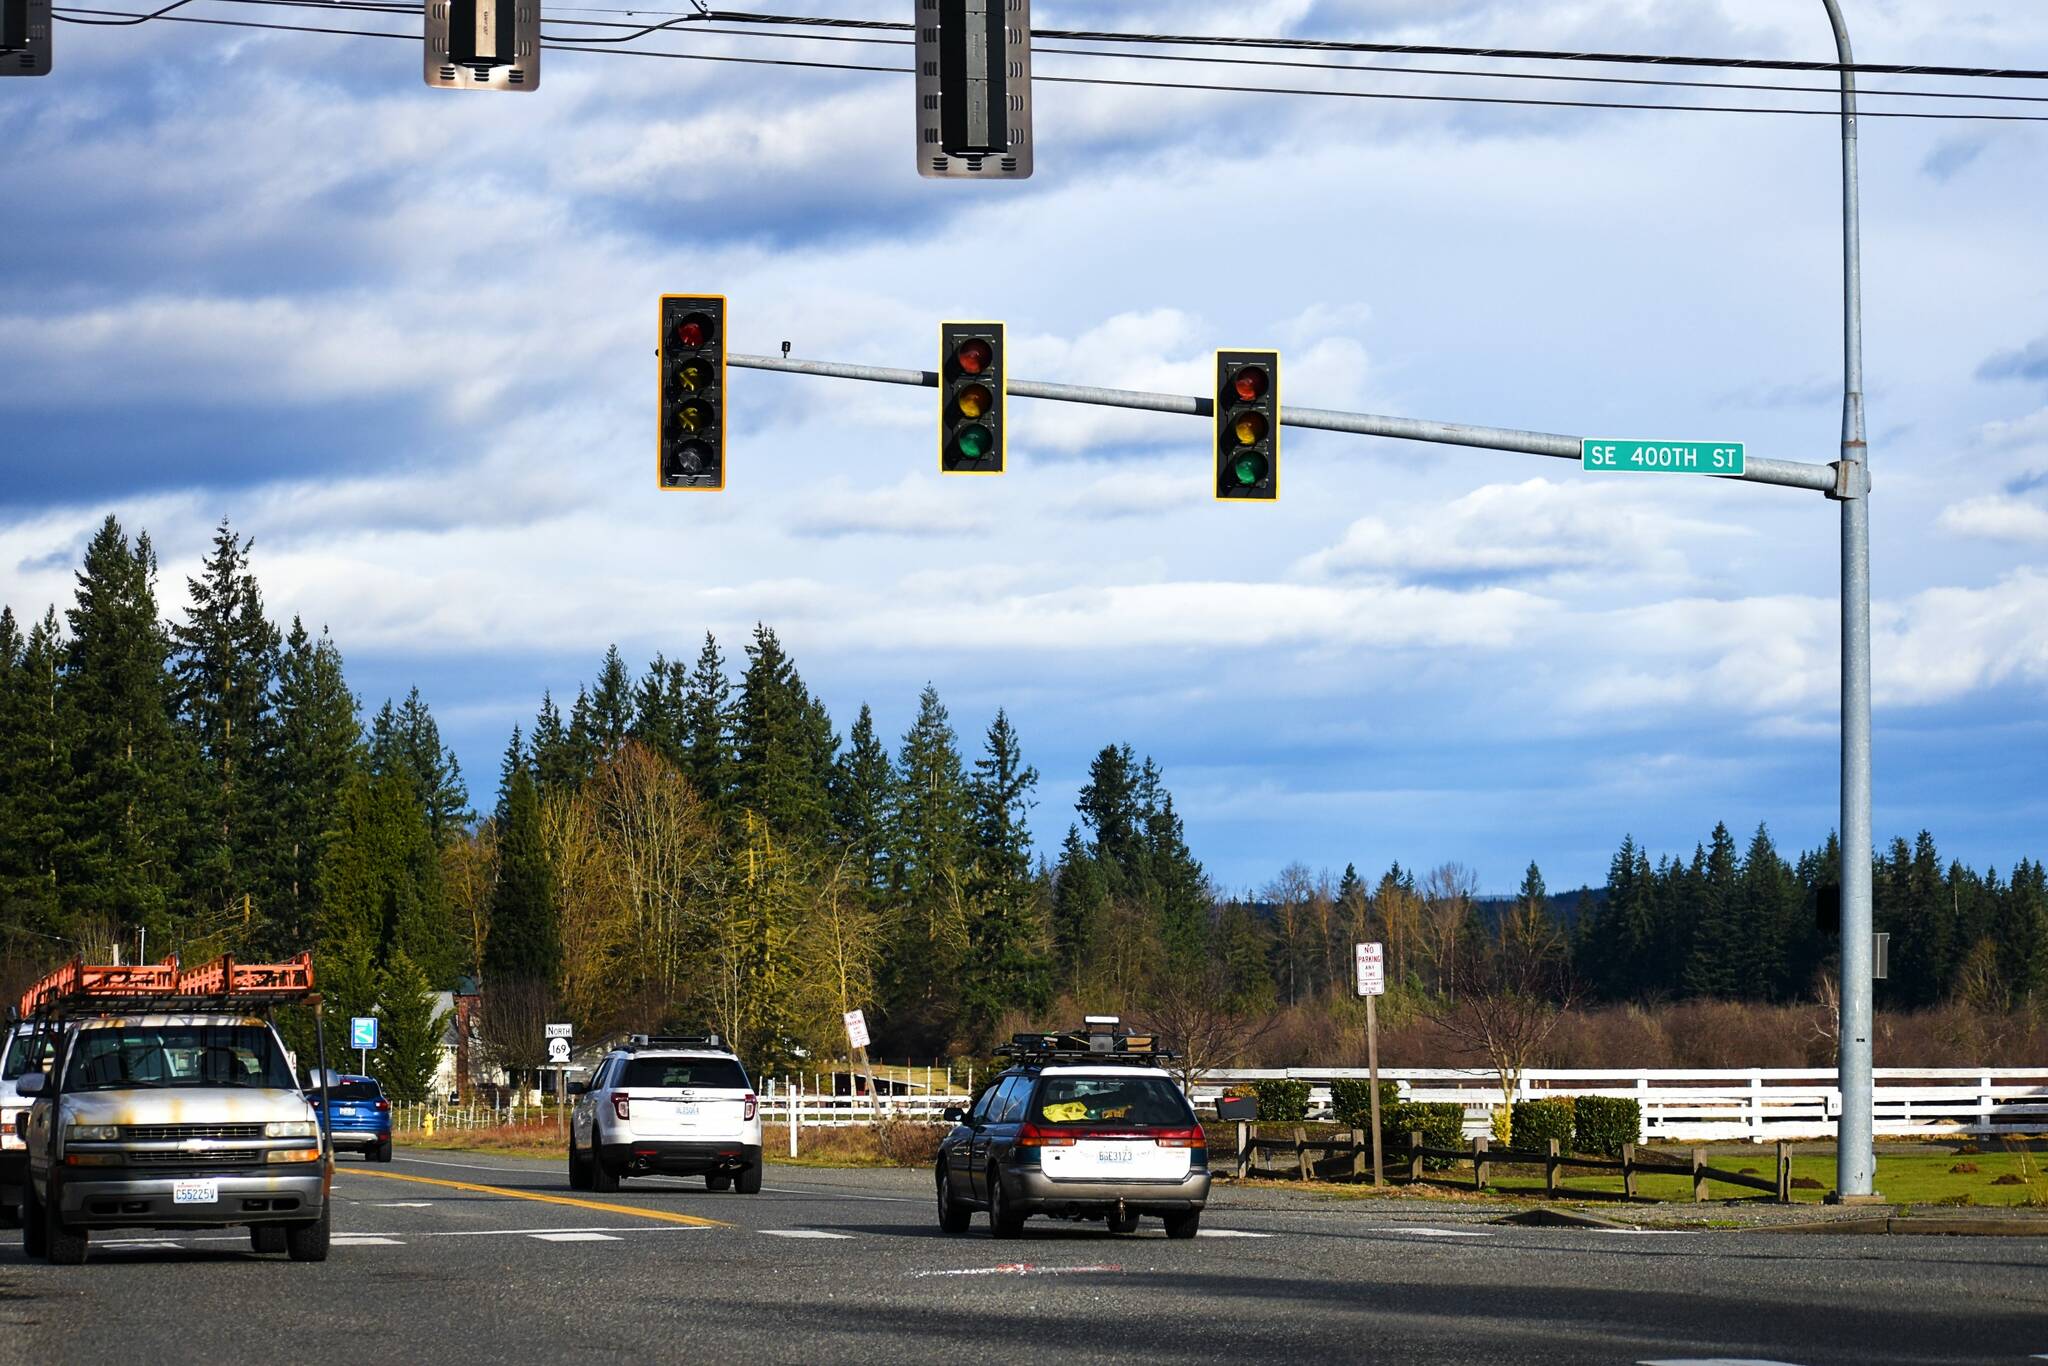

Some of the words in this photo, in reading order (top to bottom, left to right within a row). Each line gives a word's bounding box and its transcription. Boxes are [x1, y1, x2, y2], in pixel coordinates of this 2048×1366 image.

[1591, 446, 1616, 465] SE
[1630, 447, 1697, 467] 400TH
[1712, 448, 1736, 468] ST
[1364, 946, 1374, 954] NO
[1358, 955, 1381, 963] PARKING
[548, 1026, 571, 1036] NORTH
[552, 1044, 567, 1054] 169
[176, 1188, 215, 1200] C55225V
